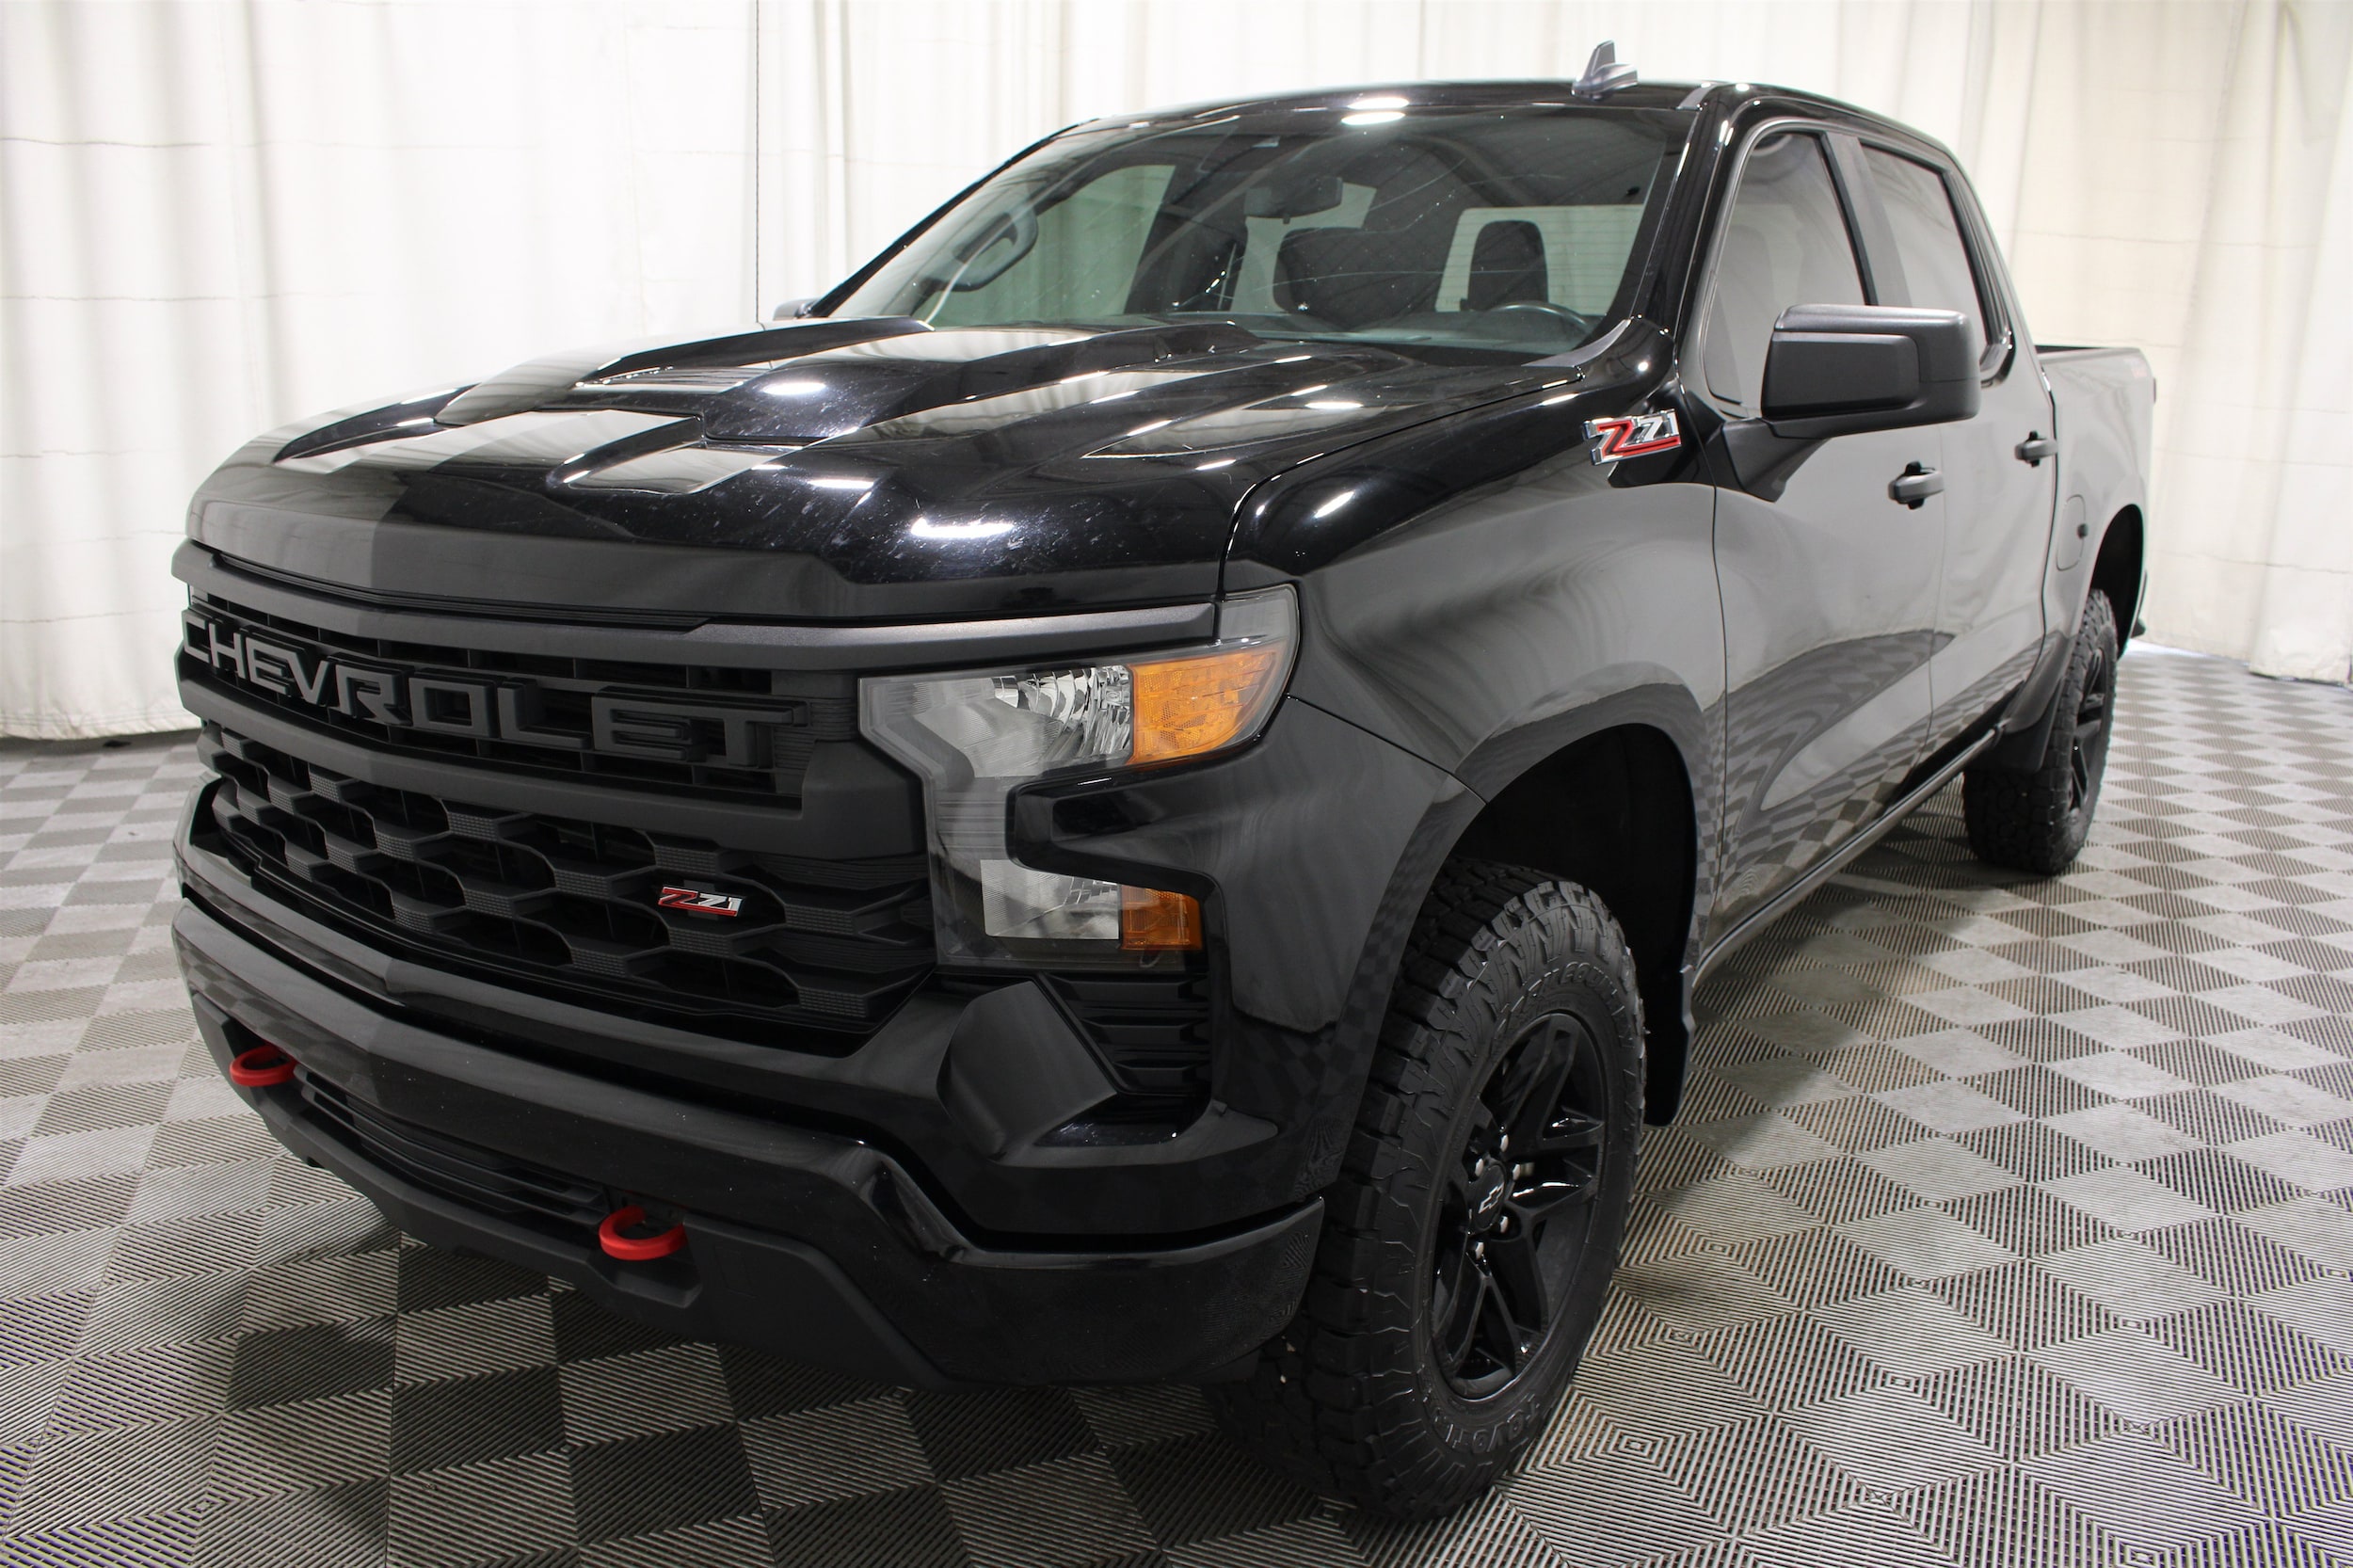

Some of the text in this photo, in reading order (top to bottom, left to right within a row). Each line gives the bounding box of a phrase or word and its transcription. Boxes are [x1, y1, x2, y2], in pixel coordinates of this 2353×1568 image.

[1583, 408, 1681, 465] Z71
[183, 605, 806, 769] CHEVROLET
[658, 887, 743, 917] Z71
